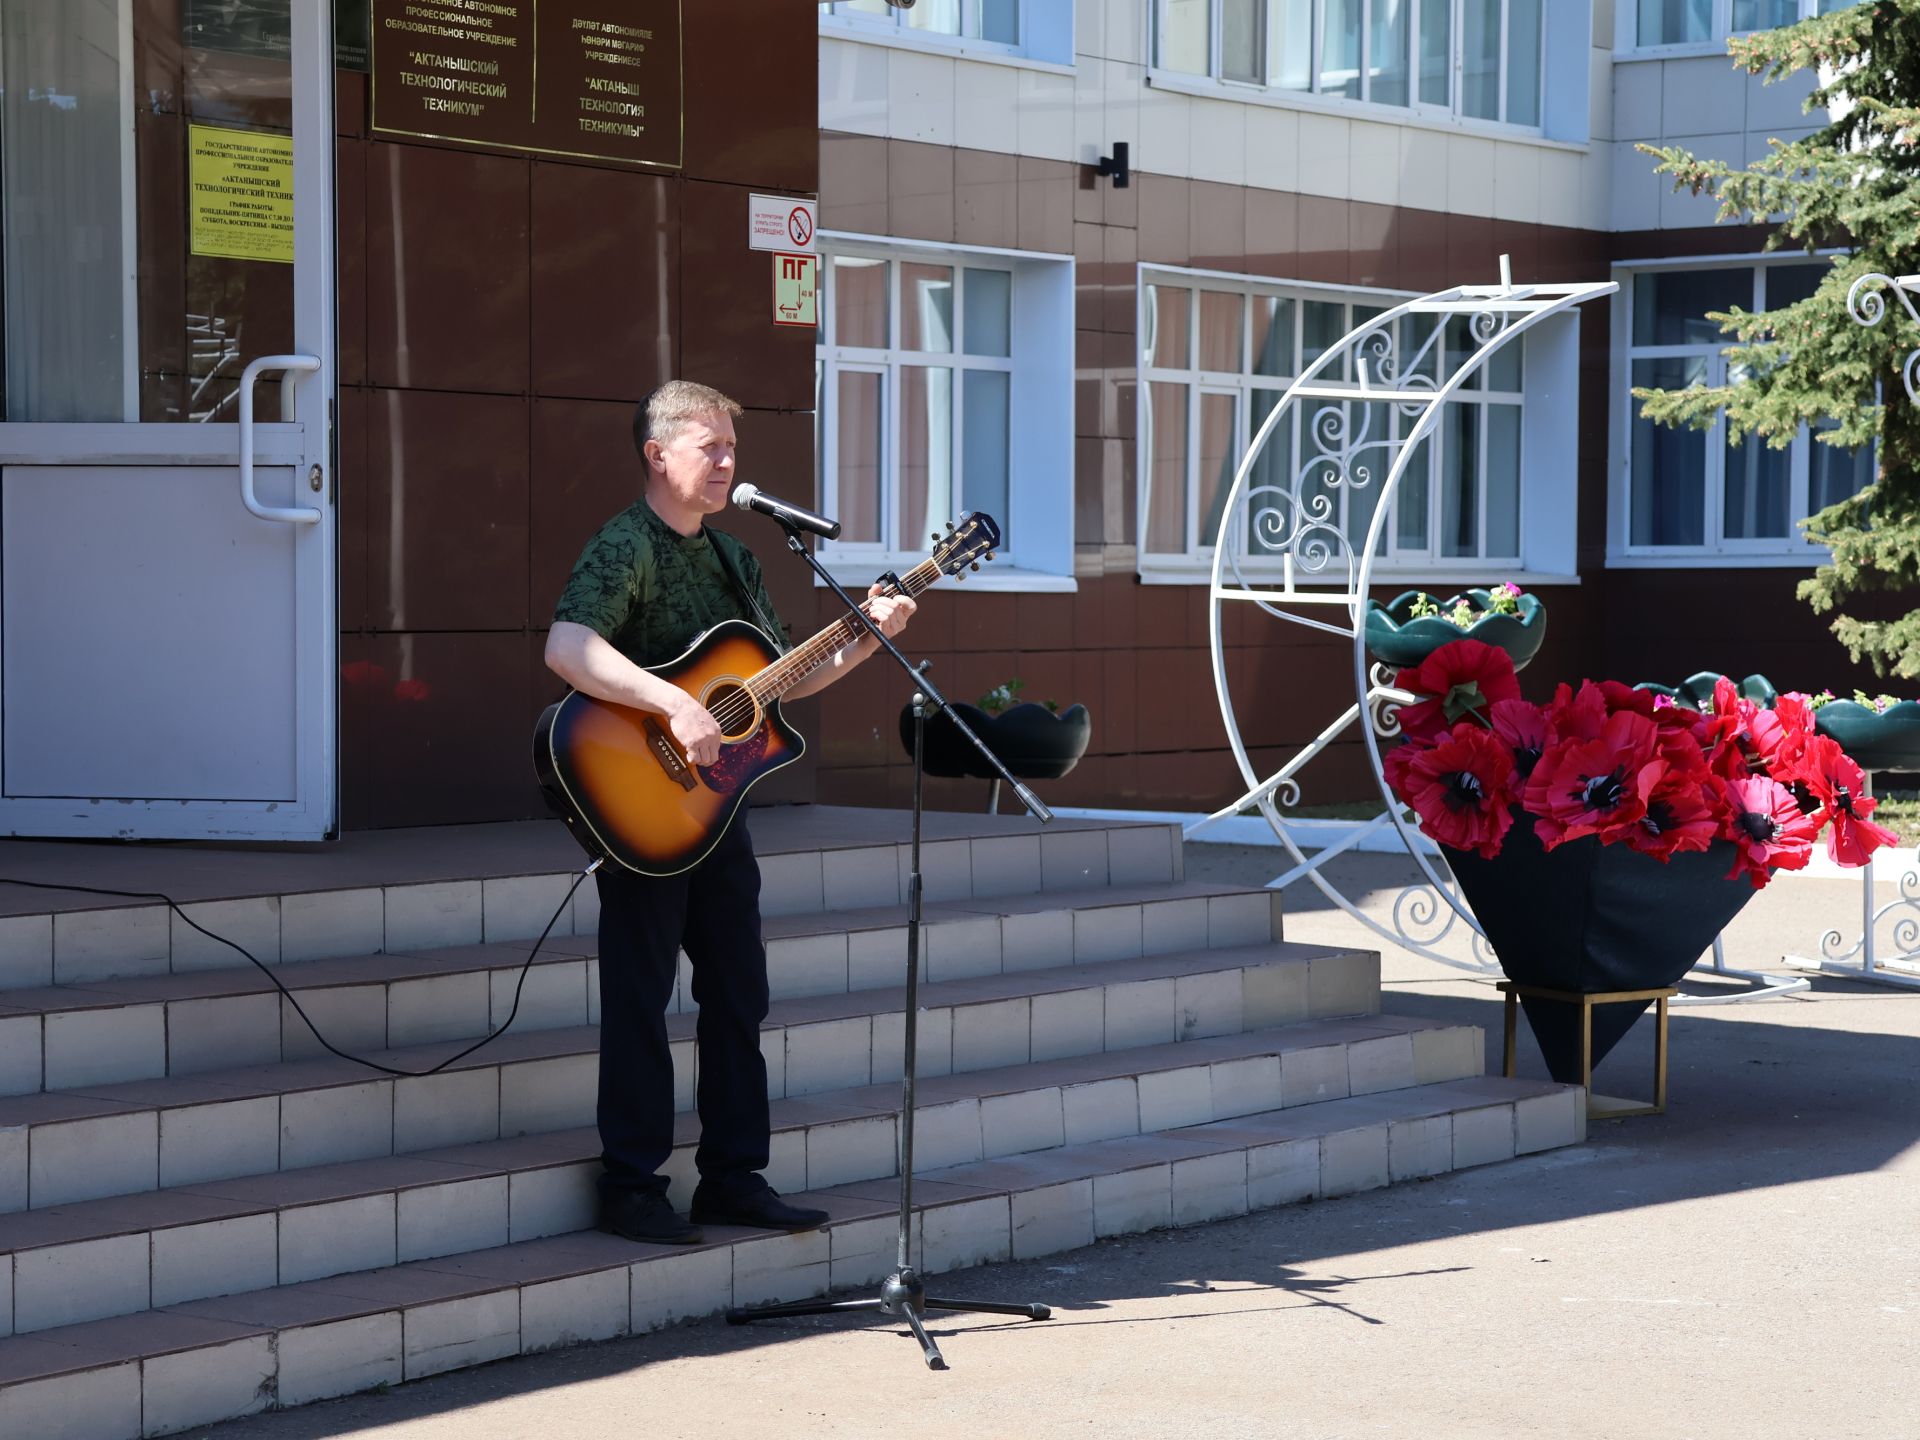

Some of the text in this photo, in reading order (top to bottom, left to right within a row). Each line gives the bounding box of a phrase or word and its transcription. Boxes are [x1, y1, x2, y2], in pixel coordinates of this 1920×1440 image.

[406, 6, 492, 28] ПРОФЕССИОНАЛЬНОЕ
[464, 0, 517, 16] АВТОНОМНОЕ
[385, 18, 517, 46] ОБРАЗОВАТЕЛЬНОЕ УЧРЕЖДЕНИЕ
[410, 52, 499, 75] “АКТАНЫШСКИЙ
[585, 50, 641, 66] УЧРЕЖДЕНИЕСЕ
[400, 72, 507, 98] ТЕХНОЛОГИЧЕСКИЙ
[585, 77, 640, 96] “АКТАНЫШ
[580, 98, 644, 117] ТЕХНОЛОГИЯ
[195, 183, 266, 197] ТЕХНОЛОГИЧЕСКИЙ
[783, 259, 807, 280] ПГ
